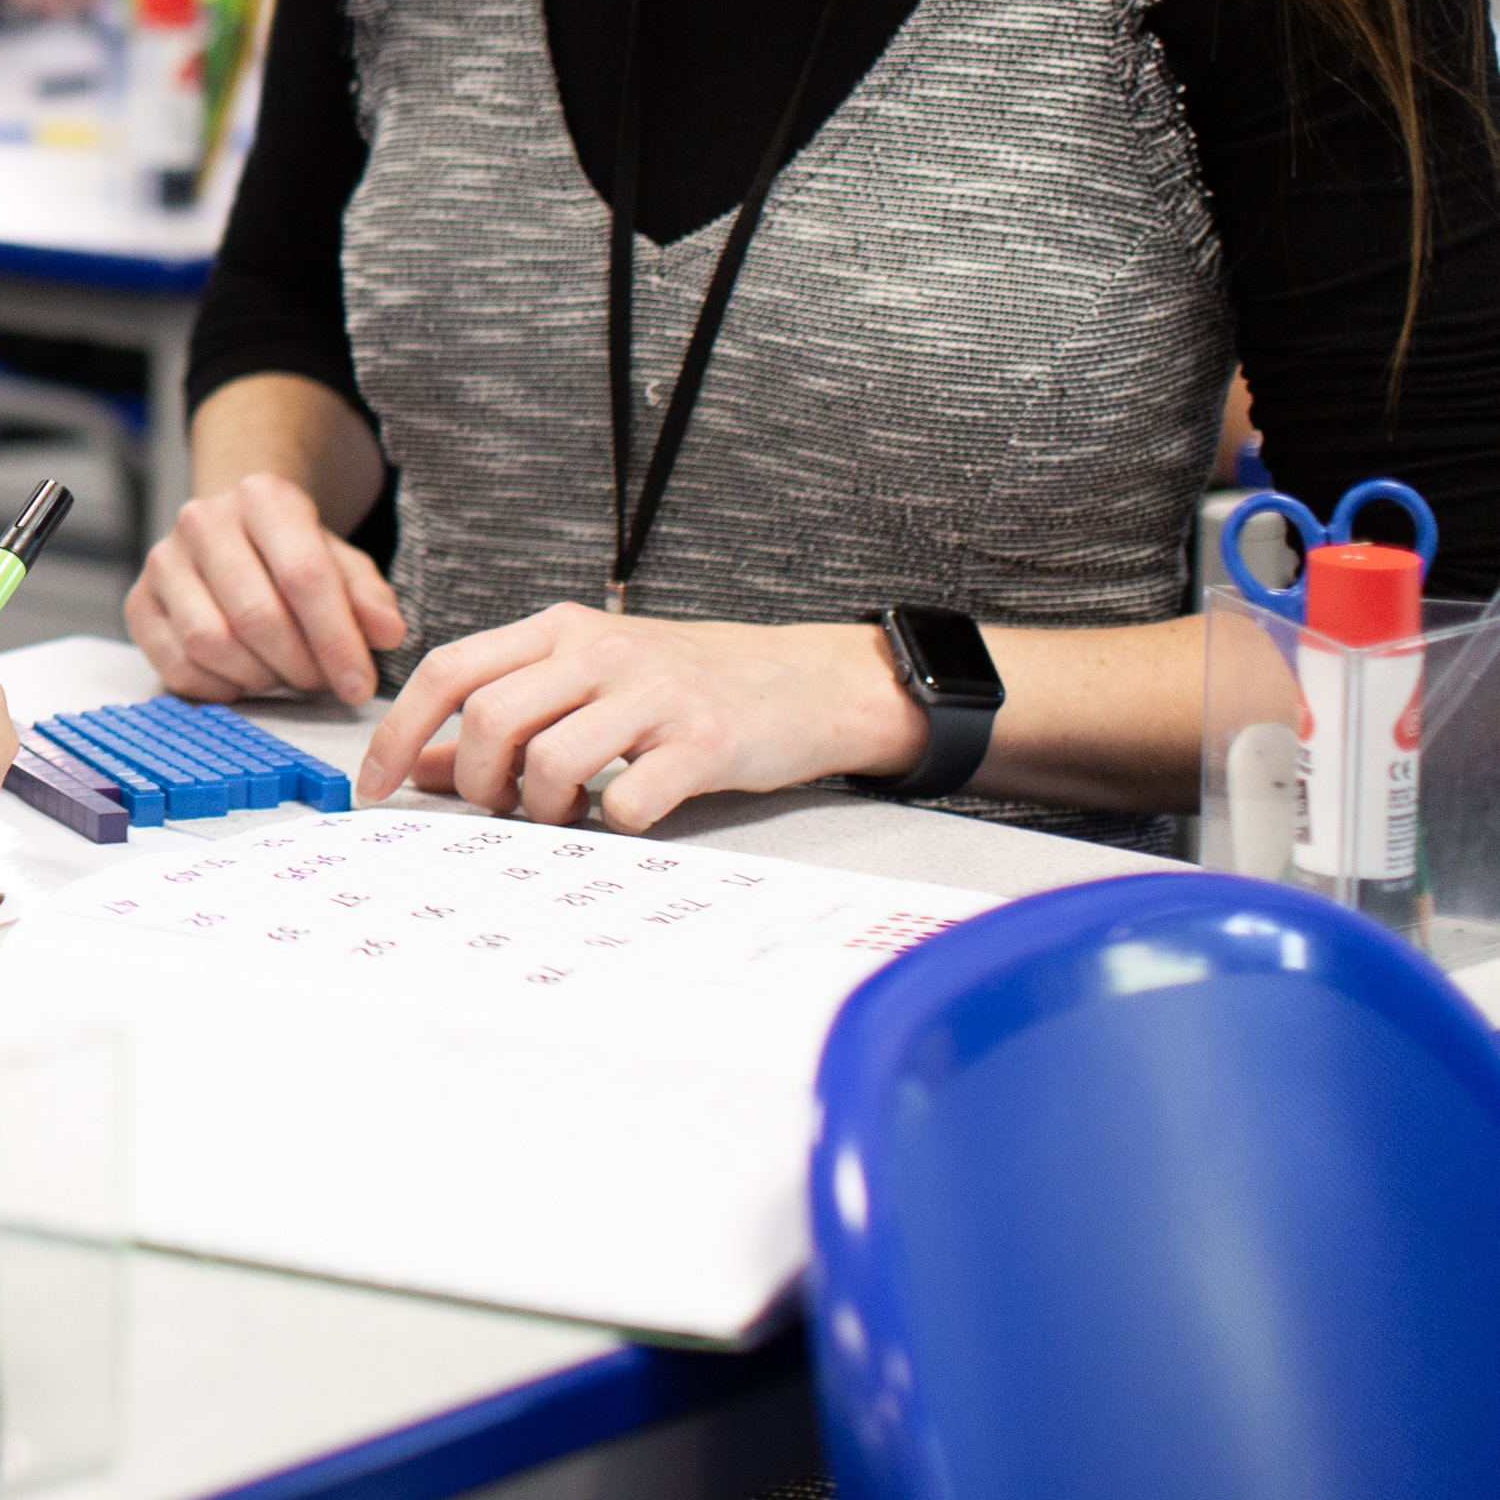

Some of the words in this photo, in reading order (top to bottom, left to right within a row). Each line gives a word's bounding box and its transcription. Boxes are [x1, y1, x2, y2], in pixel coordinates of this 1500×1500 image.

[360, 832, 404, 844] 98
[469, 831, 512, 845] 32
[442, 841, 486, 855] 33
[552, 842, 595, 859] 85
[302, 855, 347, 867] 96
[637, 857, 681, 873] 59
[163, 869, 203, 884] 49
[273, 866, 318, 881] 95
[500, 866, 541, 881] 87
[720, 872, 765, 888] 71
[582, 880, 625, 894] 61
[101, 899, 140, 915] 47
[329, 891, 371, 908] 37
[554, 892, 597, 907] 62
[667, 897, 714, 913] 73
[181, 911, 226, 928] 92
[410, 904, 456, 921] 90
[640, 909, 687, 925] 74
[266, 926, 311, 943] 39
[583, 934, 632, 949] 76
[350, 938, 398, 958] 92
[525, 965, 575, 986] 78
